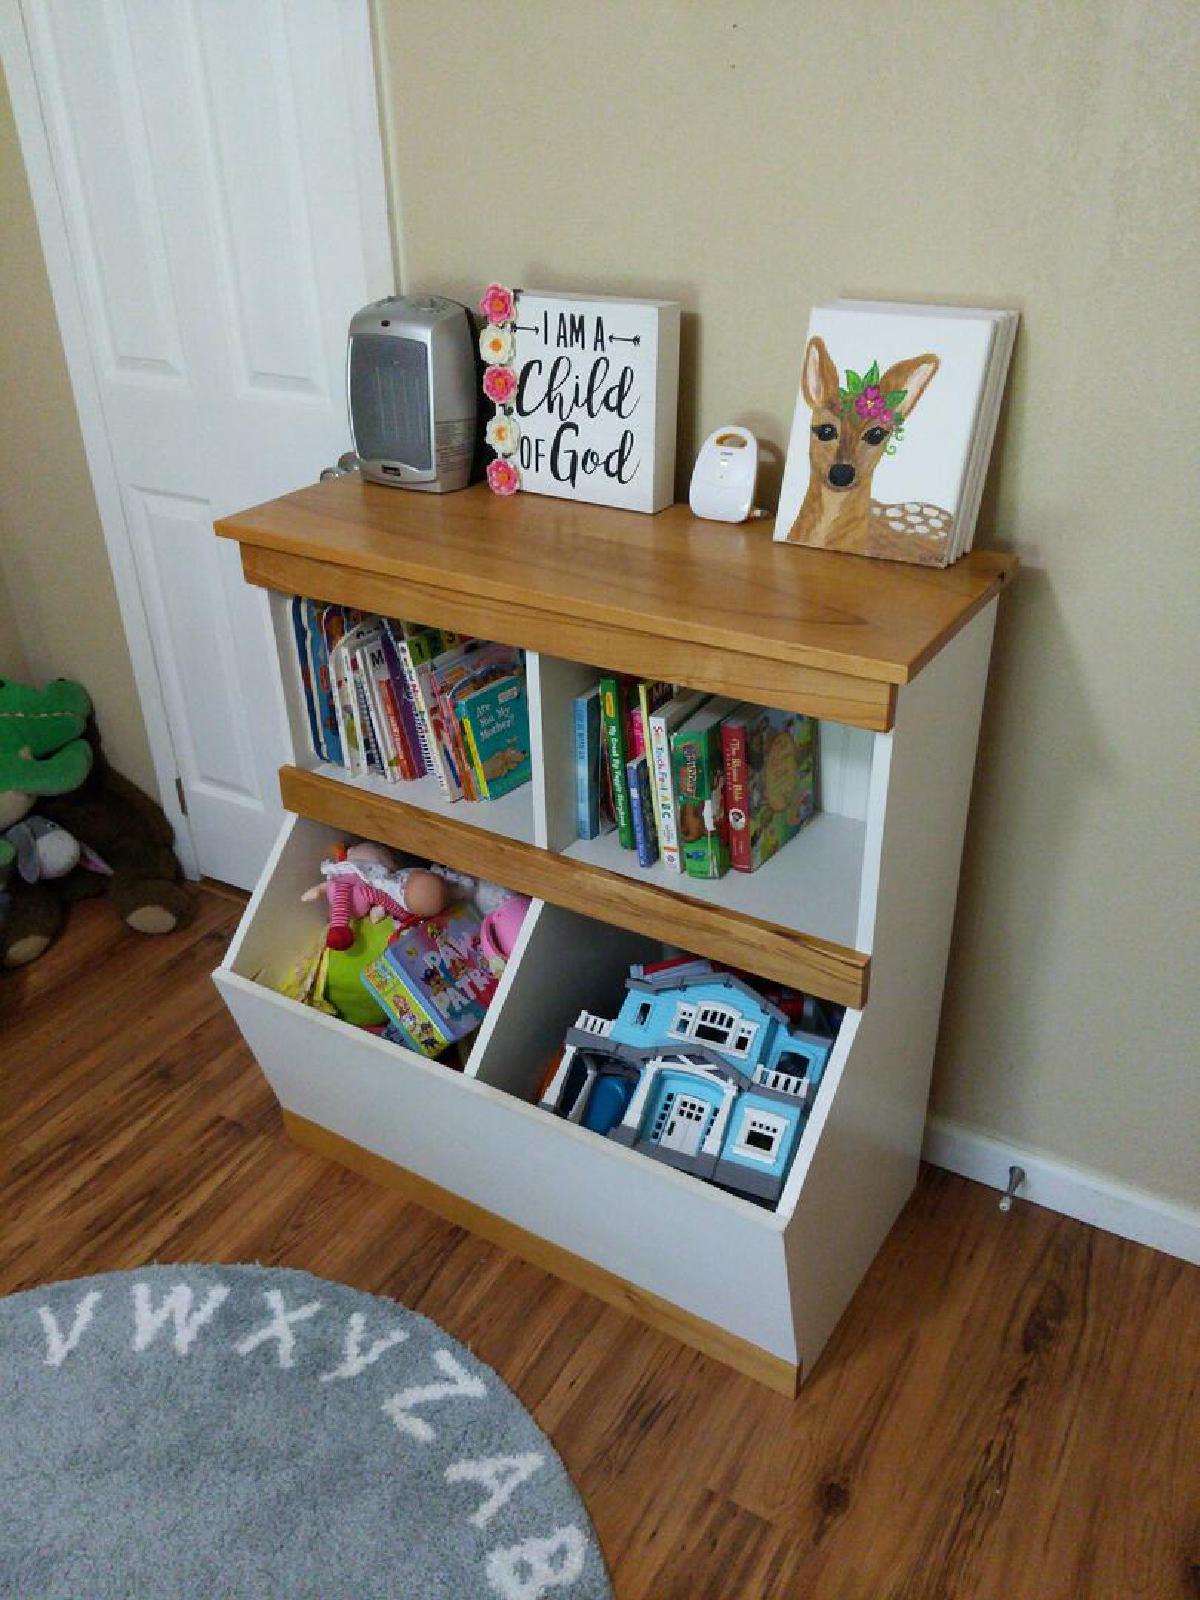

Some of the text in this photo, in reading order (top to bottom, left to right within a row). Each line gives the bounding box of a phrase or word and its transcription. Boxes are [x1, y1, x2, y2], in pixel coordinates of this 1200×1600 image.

[543, 310, 606, 352] I AM A
[516, 355, 641, 422] Child
[520, 435, 546, 474] OF
[550, 421, 641, 489] God
[38, 1283, 590, 1600] V W X Y Z A B
